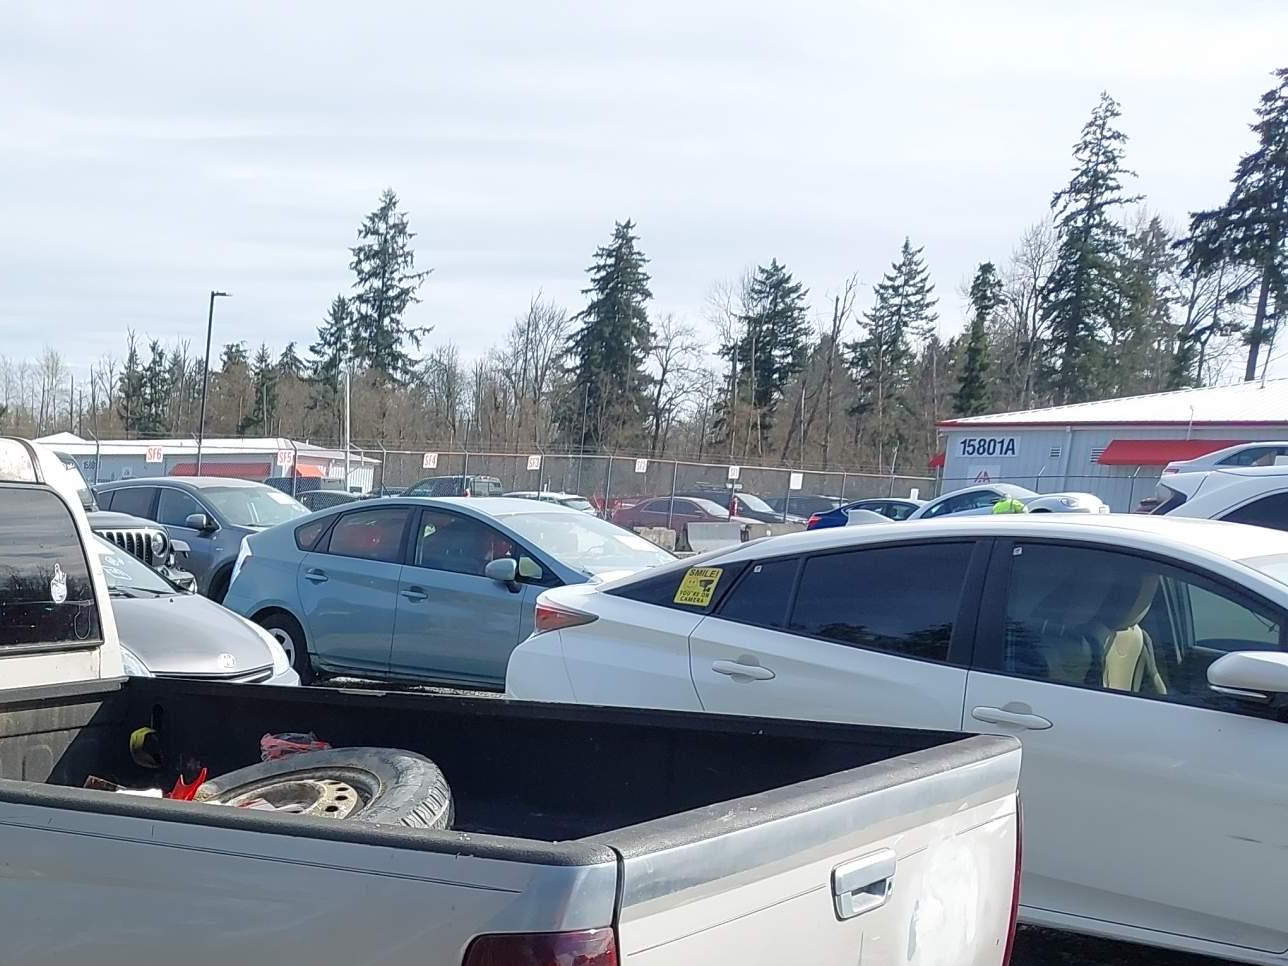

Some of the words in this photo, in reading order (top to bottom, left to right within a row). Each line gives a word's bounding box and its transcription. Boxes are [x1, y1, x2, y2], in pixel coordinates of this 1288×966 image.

[959, 437, 1017, 456] 15801A
[147, 447, 163, 461] SF6
[279, 451, 292, 464] SF5
[424, 454, 437, 467] SF4
[689, 569, 720, 578] SMILE!
[679, 596, 705, 604] CAMERA
